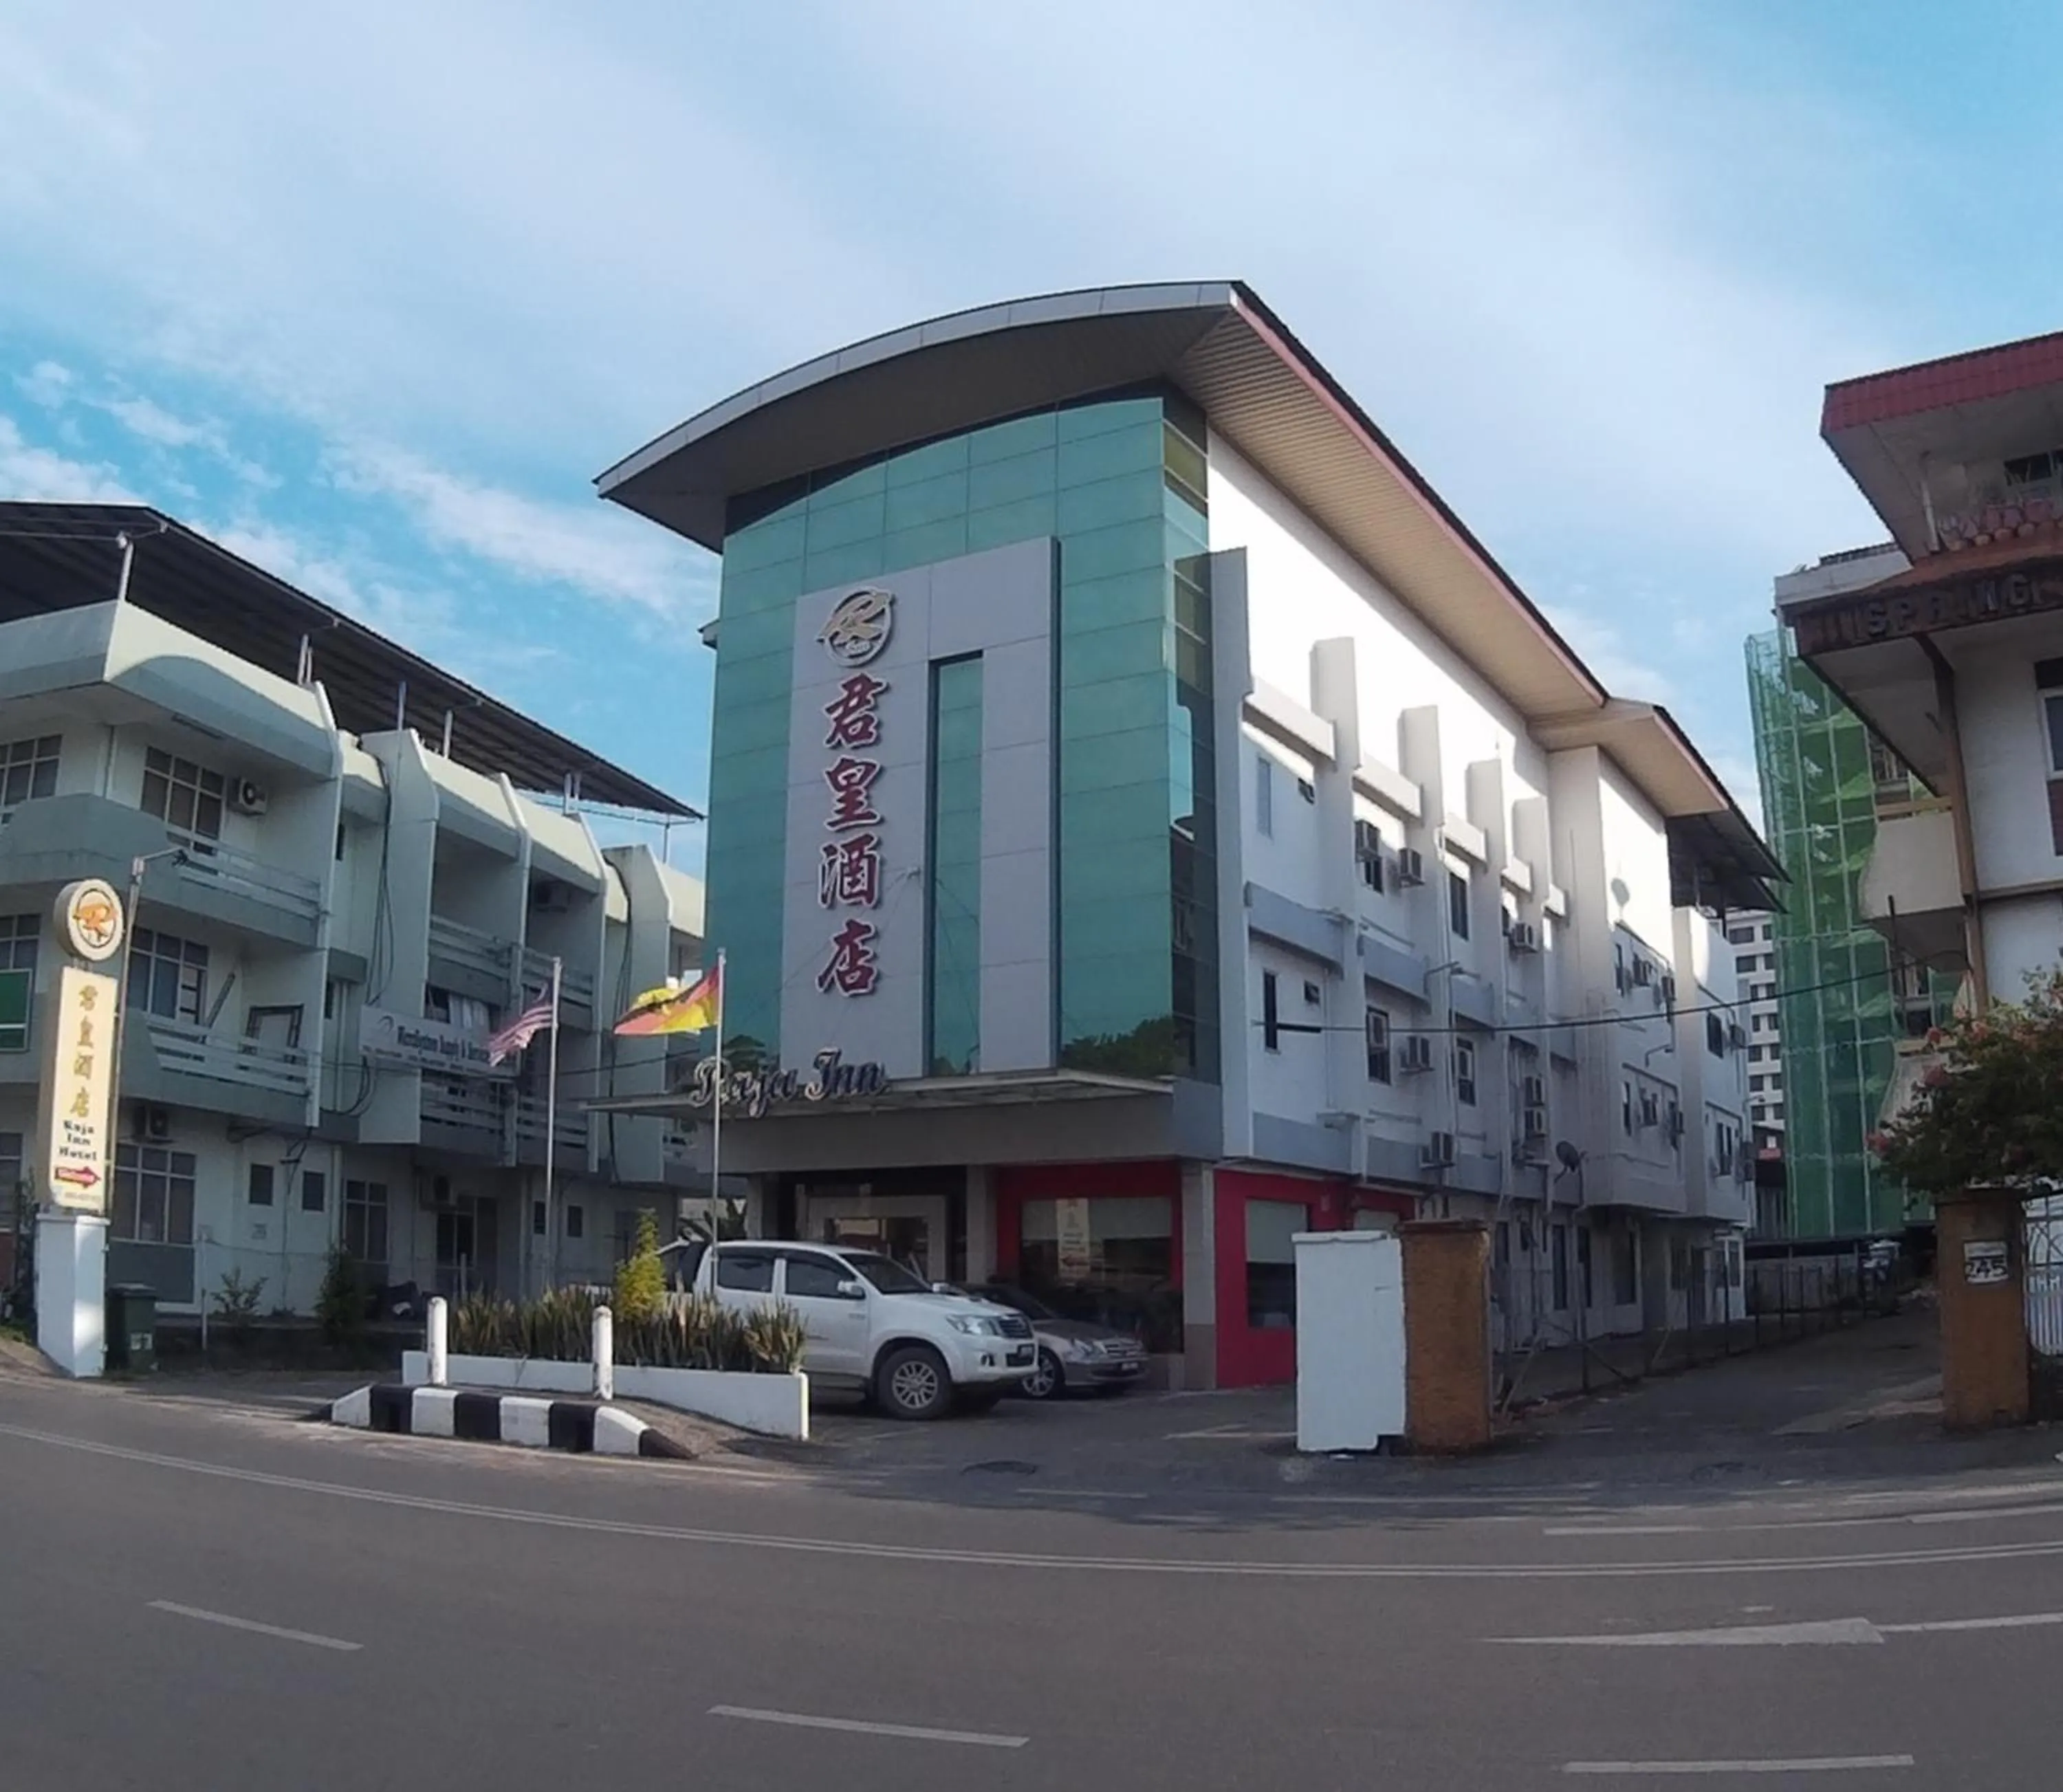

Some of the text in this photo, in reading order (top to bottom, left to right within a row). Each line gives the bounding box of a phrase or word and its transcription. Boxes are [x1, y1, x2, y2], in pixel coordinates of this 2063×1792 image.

[816, 674, 888, 998] 君皇酒店
[688, 1045, 888, 1119] Raja Inn
